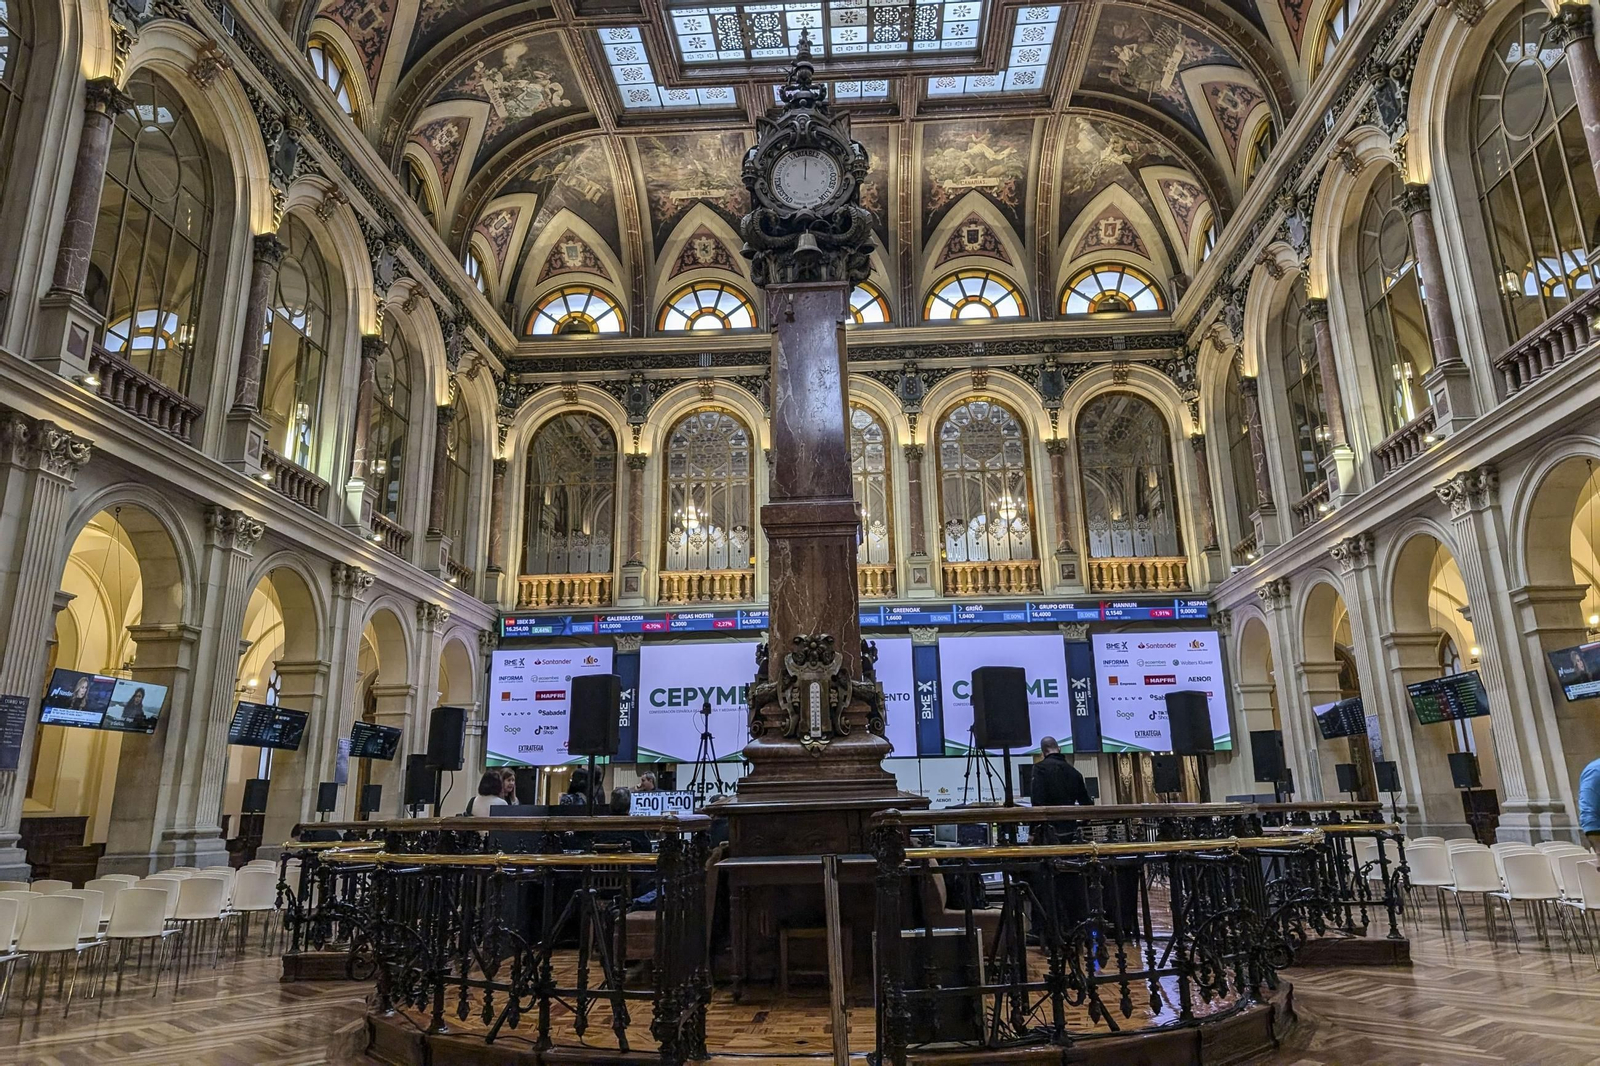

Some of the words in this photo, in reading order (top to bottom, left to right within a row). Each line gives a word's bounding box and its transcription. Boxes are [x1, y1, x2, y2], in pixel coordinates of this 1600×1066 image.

[788, 151, 820, 160] VARIABLE
[774, 177, 793, 203] TEMPESTAD
[818, 188, 831, 202] MUY
[921, 694, 931, 719] BME
[1075, 691, 1086, 716] BME
[619, 702, 628, 726] BME
[1116, 710, 1134, 720] Sage
[504, 725, 521, 734] Sage
[687, 782, 736, 793] CEPYM
[636, 797, 659, 810] 500
[668, 796, 691, 810] 500
